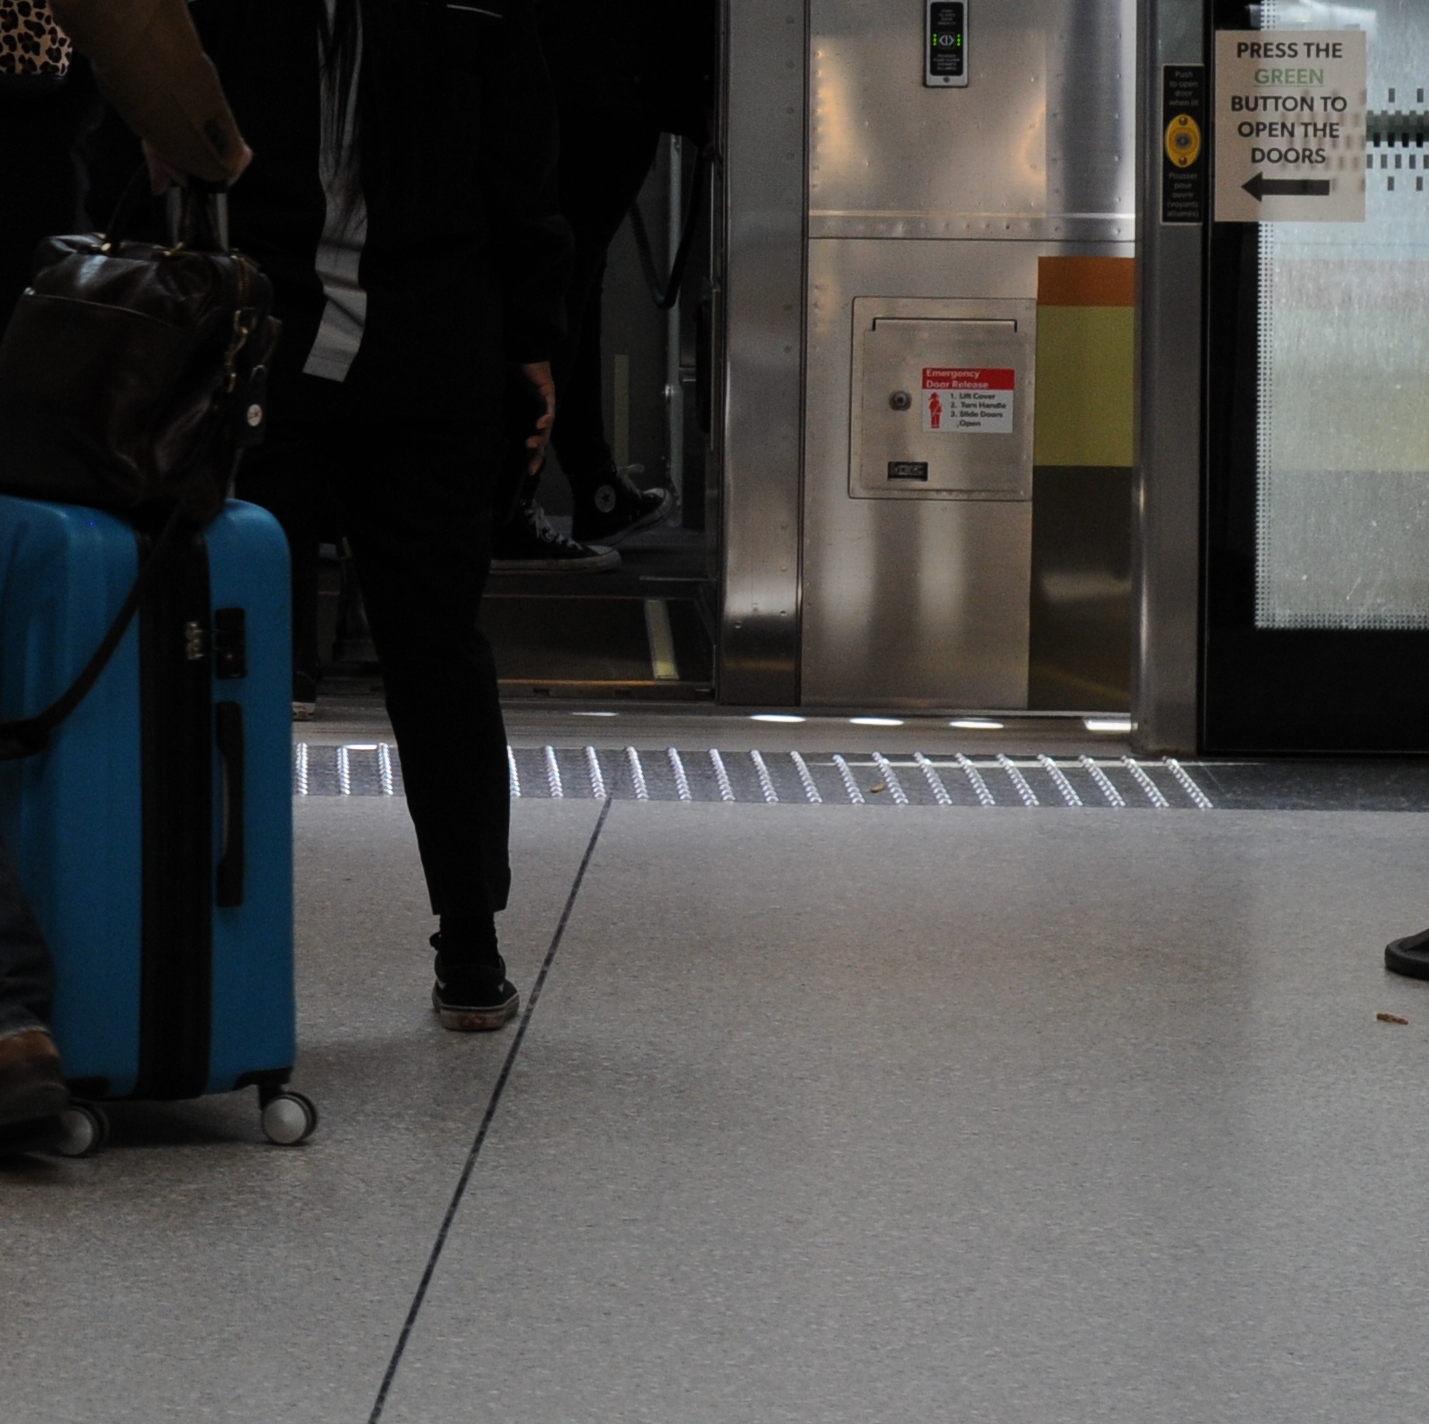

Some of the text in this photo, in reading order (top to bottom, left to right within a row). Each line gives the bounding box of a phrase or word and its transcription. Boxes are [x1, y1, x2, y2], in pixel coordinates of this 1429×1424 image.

[1236, 41, 1344, 58] PRESS THE
[1253, 68, 1325, 85] GREEN
[1231, 95, 1348, 112] BUTTON TO
[1237, 121, 1340, 138] OPEN THE
[1251, 147, 1327, 164] DOORS
[925, 369, 981, 379] Emergency
[925, 380, 989, 388] Door Release
[978, 401, 1007, 409] Handle
